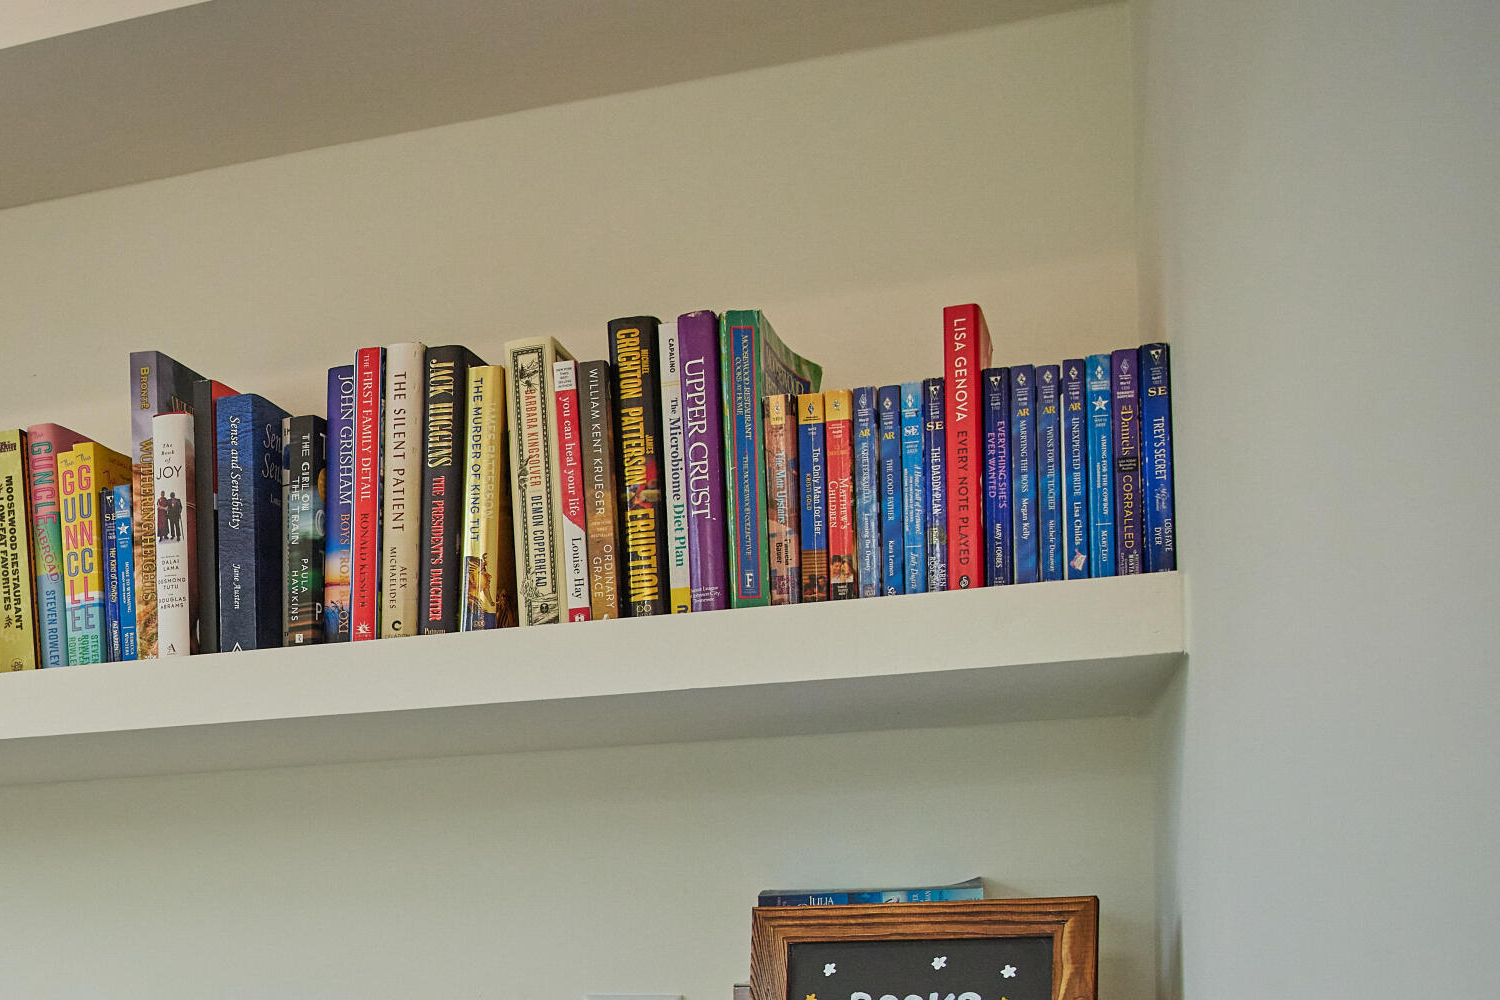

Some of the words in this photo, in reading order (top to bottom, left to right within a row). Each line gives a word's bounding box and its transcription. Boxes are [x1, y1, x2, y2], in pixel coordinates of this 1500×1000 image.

[953, 318, 966, 351] LISA
[394, 372, 406, 399] THE
[685, 357, 707, 438] UPPER
[954, 357, 968, 422] GENOVA
[526, 390, 537, 429] BARBARA
[559, 397, 570, 416] you
[229, 416, 239, 443] Sense
[393, 408, 406, 458] SILENT
[564, 420, 572, 440] can
[230, 448, 239, 471] and
[527, 432, 540, 486] KINGSOLVER
[566, 443, 576, 466] heal
[956, 431, 967, 471] EVERY
[157, 465, 182, 480] JOY
[564, 470, 576, 495] your
[688, 443, 710, 519] CRUST
[228, 477, 240, 529] Sensibility
[392, 467, 406, 531] PATIENT
[530, 496, 542, 526] DEMON
[570, 498, 579, 516] life
[958, 476, 968, 511] NOTE
[5, 475, 17, 549] MOOSEWOOD
[11, 553, 23, 630] RESTAURANT
[532, 530, 547, 587] COPPERHEAD
[571, 538, 581, 573] Louise
[625, 508, 659, 602] ERUPTION
[959, 515, 970, 566] PLAYED
[1, 550, 11, 611] FAVORITES
[573, 577, 584, 600] Hay
[46, 590, 55, 623] STEVEN
[48, 627, 60, 666] ROWLEY
